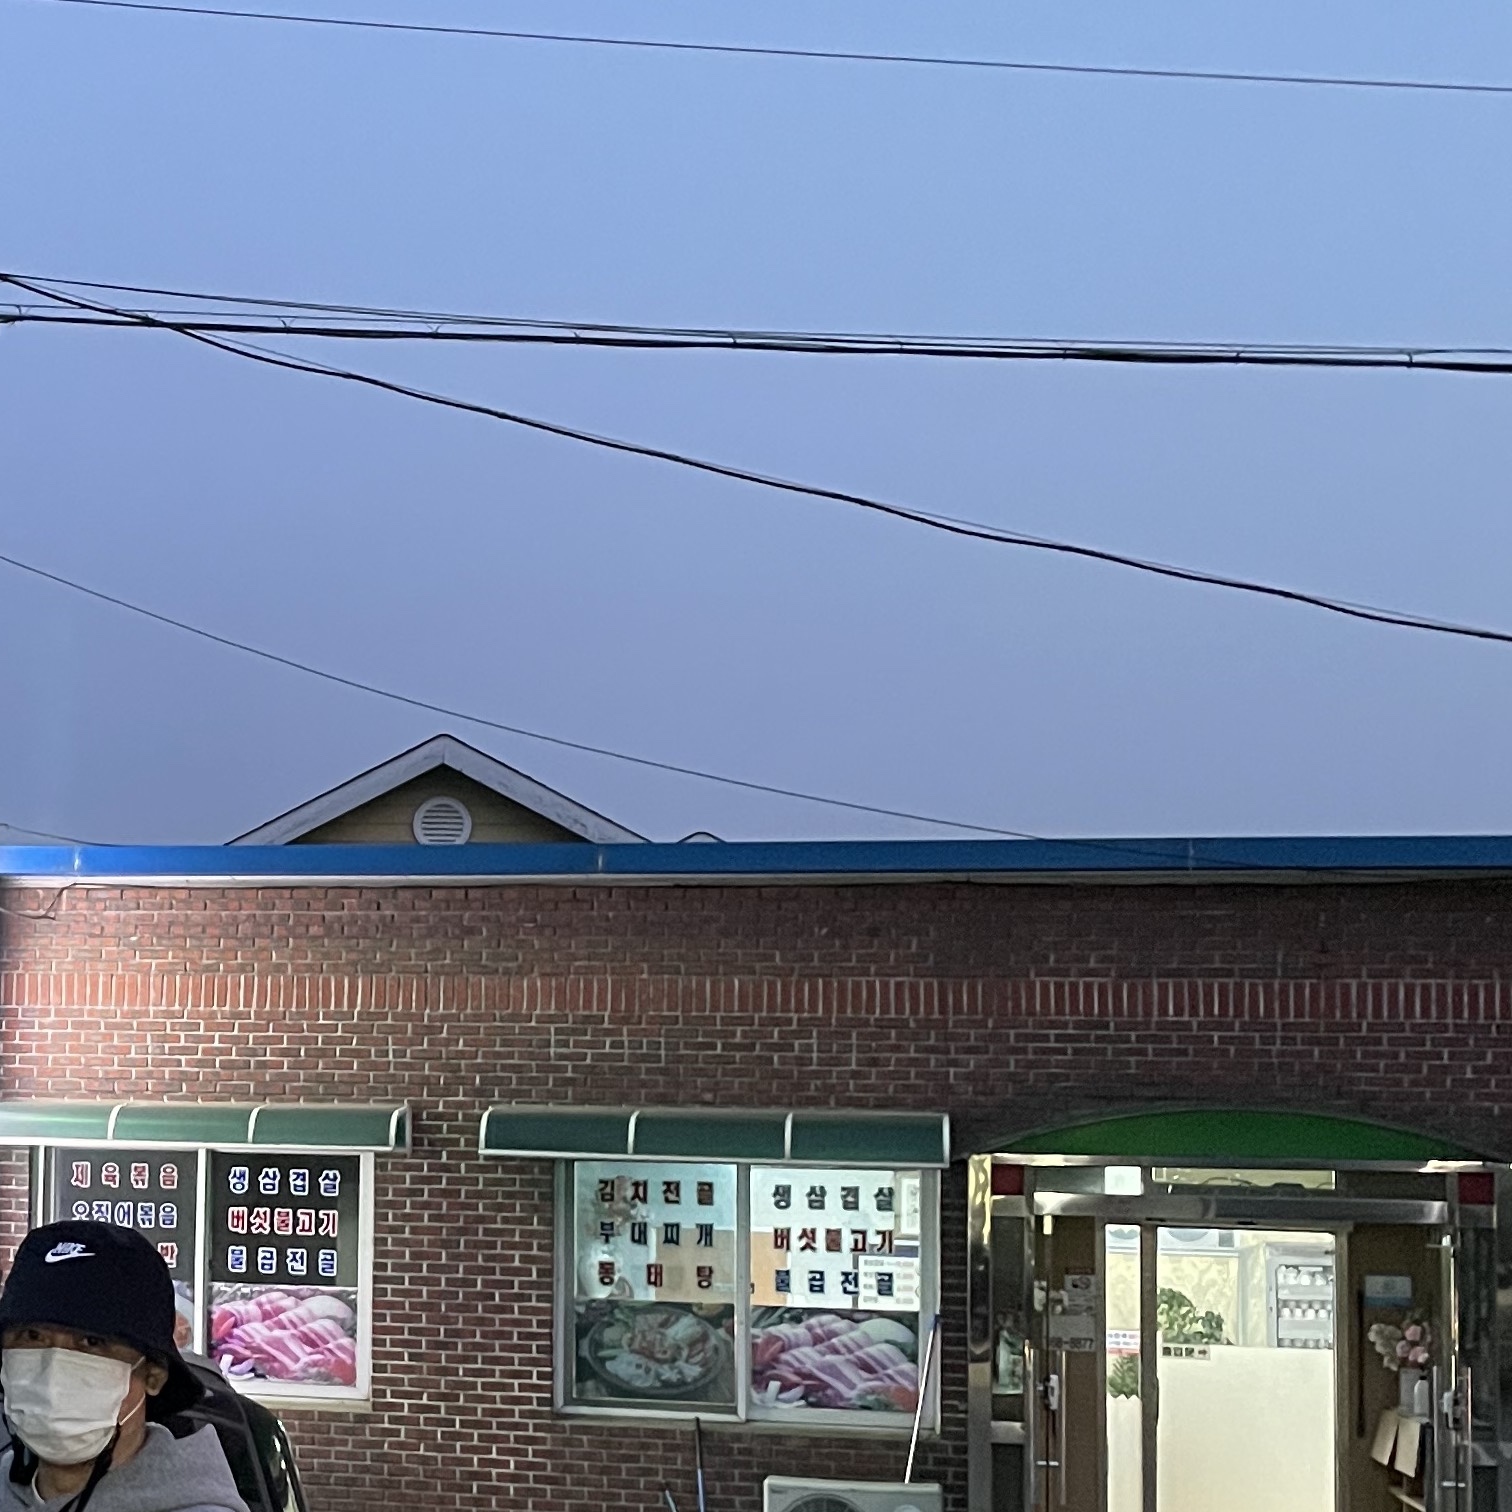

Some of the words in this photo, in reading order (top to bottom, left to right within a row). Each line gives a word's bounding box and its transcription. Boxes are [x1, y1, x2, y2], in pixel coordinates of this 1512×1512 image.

[71, 1161, 178, 1189] 제육볶음
[228, 1166, 341, 1197] 생삼겹살
[598, 1179, 714, 1206] 김치전골
[773, 1184, 894, 1212] 생삼겹살
[228, 1206, 339, 1238] 버섯불고기
